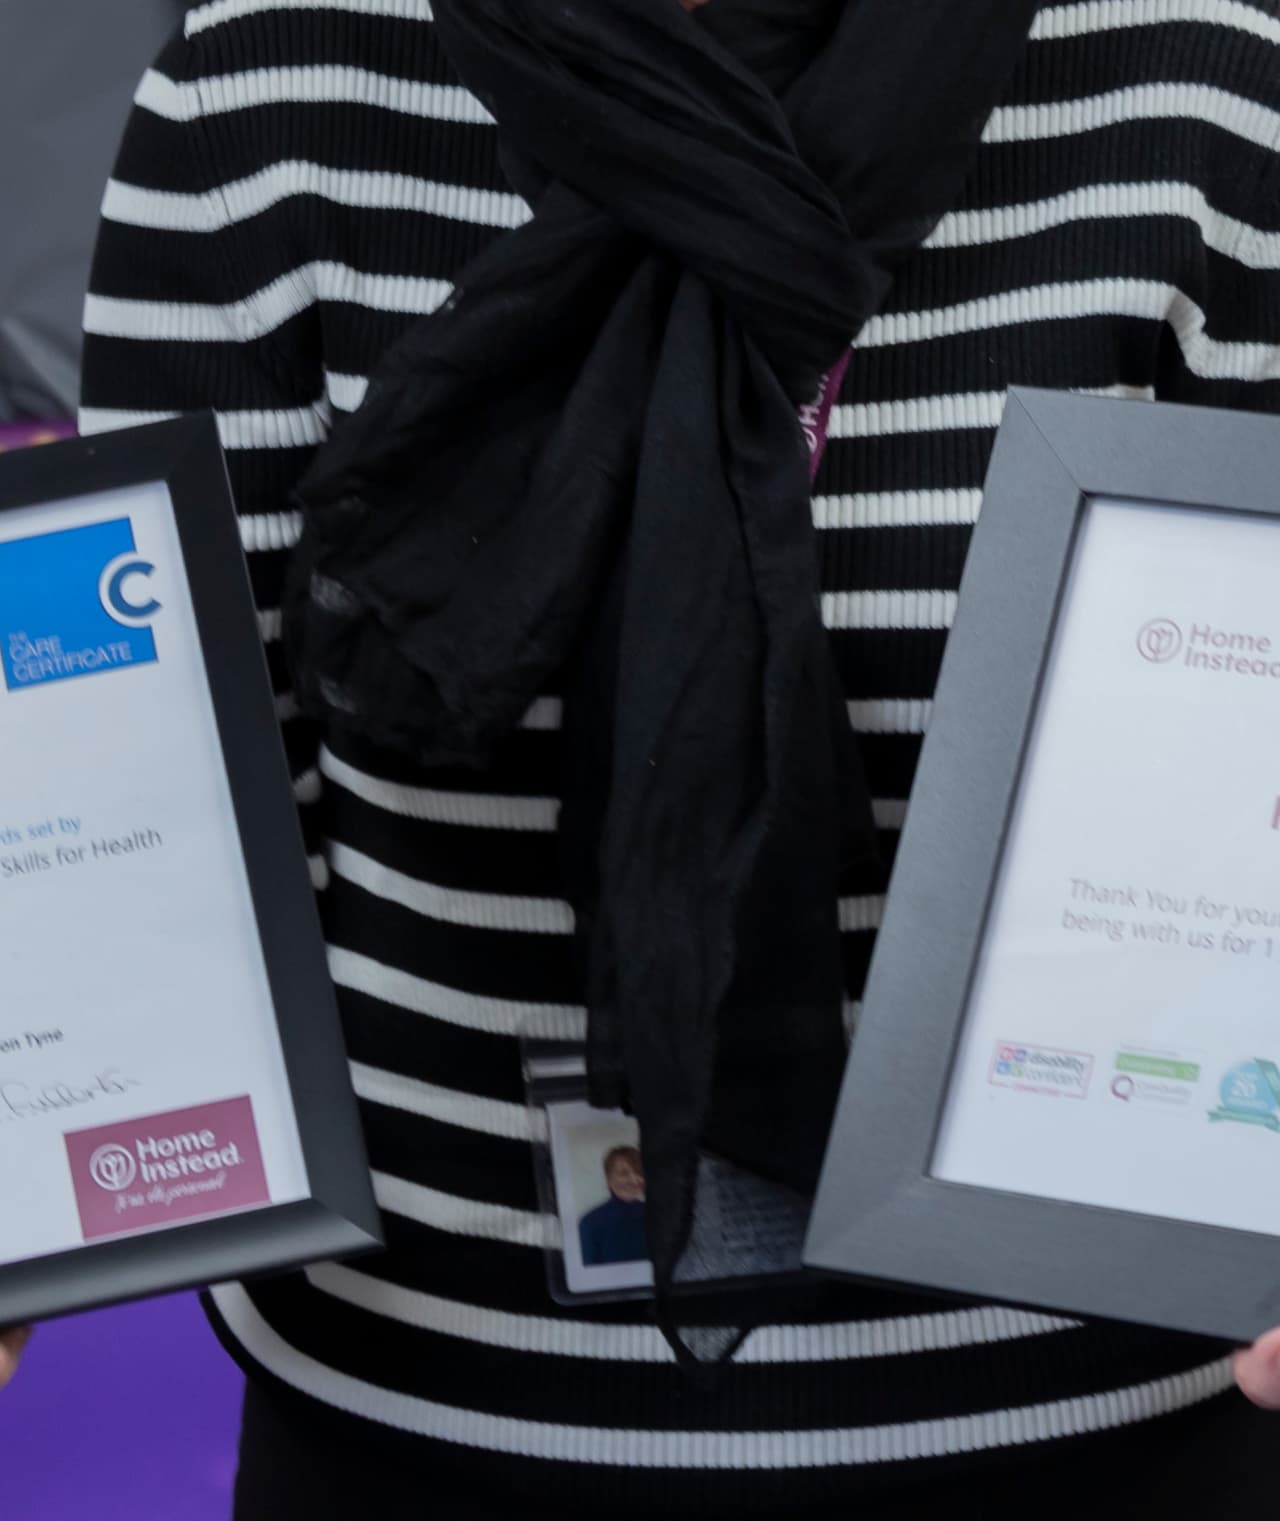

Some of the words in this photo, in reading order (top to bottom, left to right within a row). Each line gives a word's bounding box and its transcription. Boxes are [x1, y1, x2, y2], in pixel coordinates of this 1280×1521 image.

[1190, 622, 1273, 654] Home
[12, 641, 133, 682] CERTIFICATE
[26, 819, 55, 841] set
[57, 815, 82, 835] by
[0, 847, 52, 879] Skills
[55, 842, 87, 867] for
[90, 825, 164, 860] Health
[1069, 877, 1137, 908] Thank
[1144, 888, 1188, 916] You
[1194, 895, 1229, 922] for
[1061, 908, 1127, 944] being
[1130, 918, 1181, 947] with
[1186, 929, 1216, 951] us
[1220, 929, 1258, 957] for
[23, 1027, 64, 1050] Tyne
[135, 1128, 216, 1162] Home
